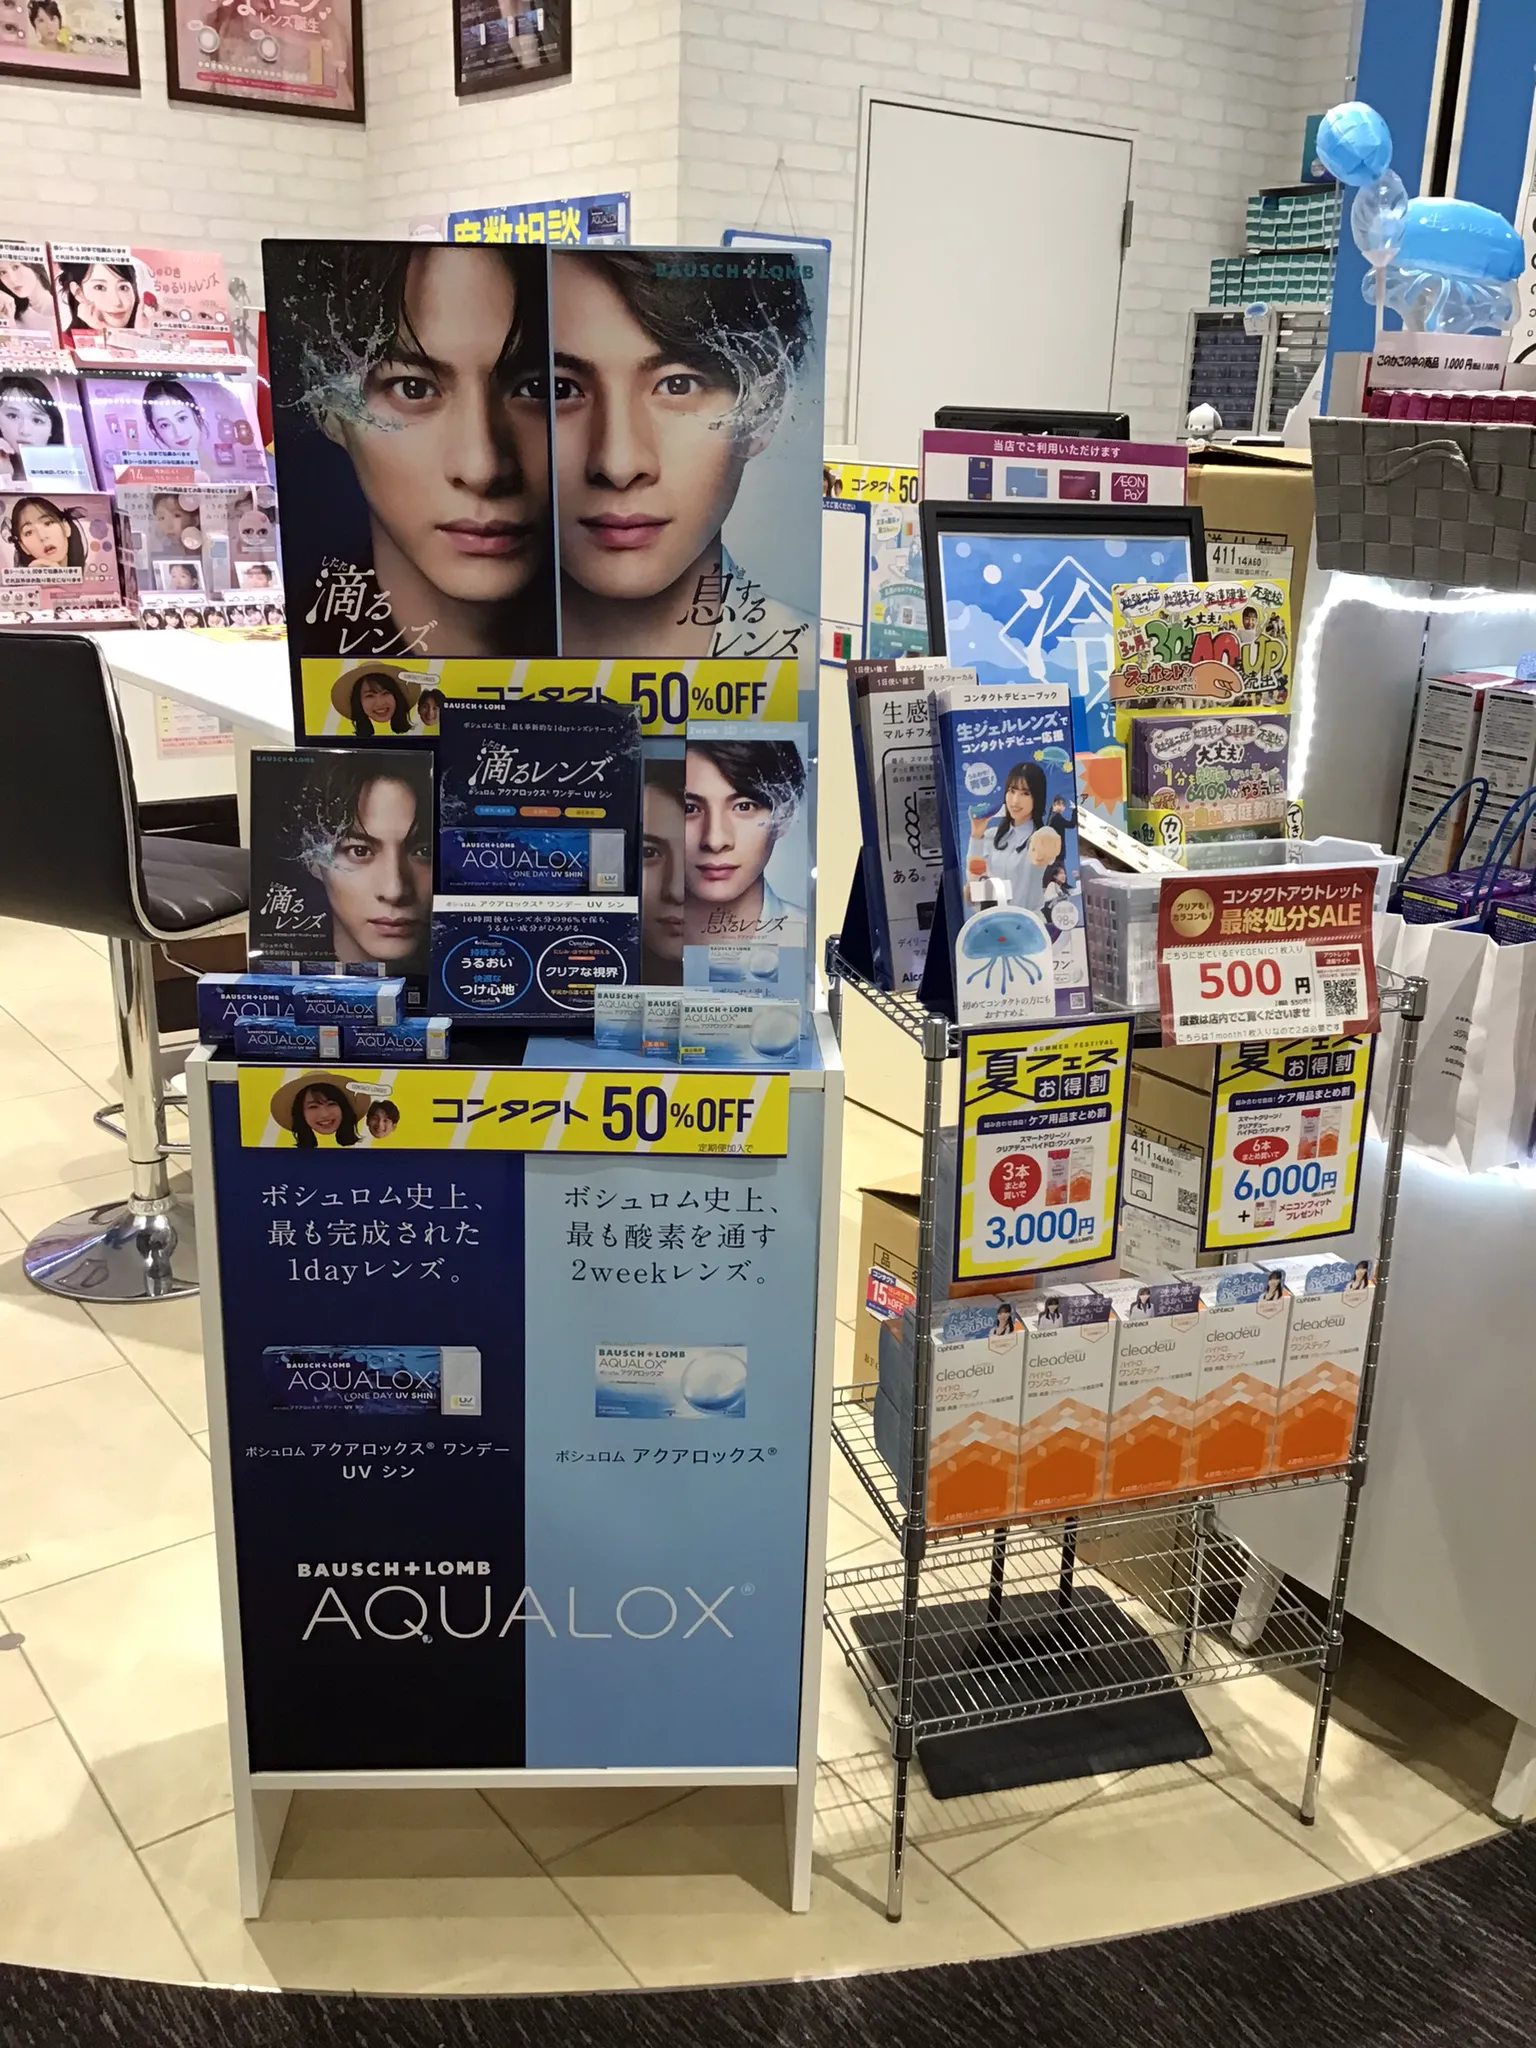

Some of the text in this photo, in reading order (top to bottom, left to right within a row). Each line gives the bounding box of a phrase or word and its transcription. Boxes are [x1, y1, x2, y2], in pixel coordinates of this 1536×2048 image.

[260, 12, 321, 34] レンズ誕生
[1376, 355, 1440, 369] このかごの中の商品
[993, 438, 1121, 459] 当店でご利用いただけます
[851, 478, 896, 494] コンタクト
[321, 556, 349, 572] したた
[1213, 546, 1236, 566] 411
[305, 564, 394, 625] 滴る
[676, 562, 767, 626] 息する
[339, 620, 439, 657] レンズ
[711, 623, 810, 658] レンズ
[876, 674, 974, 686] 1日使い捨て マルチフォーカル
[443, 702, 506, 710] BAUSCH+LOMB
[963, 691, 1058, 703] コンタクトデビューブック
[956, 711, 1069, 743] 生ジェルレンズで
[961, 729, 1065, 754] コンタクトデビュー応援
[1197, 743, 1244, 766] 大丈夫!
[468, 743, 614, 787] 滴るレンズ
[468, 788, 613, 799] ボシュロム ワンデー UV シン
[461, 850, 584, 870] AQUALOX
[893, 868, 928, 884] ある。
[260, 886, 305, 915] 滴る
[1222, 882, 1364, 905] コンタクトアウトレット
[547, 900, 625, 909] ワンデー UV シン
[1176, 901, 1211, 912] クリアも!
[274, 911, 327, 931] レンズ
[462, 915, 611, 925] 16時間後もレンズ水分の96%を保ち、
[700, 906, 789, 934] 息するレンズ
[1172, 911, 1213, 923] カラコンも!
[1219, 902, 1362, 936] 最終処分SALE
[486, 924, 584, 933] うるおい成分がひろがる。
[470, 948, 507, 957] 持続する
[1165, 945, 1304, 961] こちらに出ているEYEGENIC1枚入り
[545, 965, 619, 978] クリアな視界
[1198, 957, 1283, 1000] 500
[1294, 976, 1312, 995] 円
[220, 993, 280, 1001] BAUSCH+LOMB
[459, 983, 516, 996] つけ心地
[306, 1003, 373, 1015] AQUALOX
[684, 1006, 754, 1014] BAUSCH+LOMB
[961, 996, 1051, 1011] 初めてコンタクトの方にも
[984, 1007, 1031, 1020] おすすめよ。
[1179, 1007, 1311, 1031] 度数は店内でご覧くださいませ
[247, 1033, 317, 1045] AQUALOX
[356, 1035, 424, 1048] AQUALOX
[1177, 1023, 1342, 1044] こちらは1month1枚入りなので2点必要です
[1033, 1038, 1115, 1053] SUMMER FESTIVAL
[1288, 1052, 1353, 1078] お得割
[964, 1046, 1119, 1107] 夏フェス
[1038, 1073, 1108, 1100] お得割
[1277, 1085, 1351, 1105] ケア用品まとめ割
[432, 1097, 590, 1126] コンタクト
[1027, 1107, 1107, 1127] ケア用品まとめ割
[697, 1142, 755, 1155] 定期便加入で
[1130, 1138, 1151, 1160] 411
[1251, 1138, 1272, 1152] 6本
[1241, 1149, 1281, 1161] まとめ買いで
[1001, 1161, 1030, 1181] 3本
[1003, 1180, 1027, 1191] まとめ
[1232, 1160, 1338, 1202] 6,000円
[261, 1184, 484, 1213] ボシュロム史上、
[564, 1186, 780, 1215] ボシュロム史上、
[1002, 1189, 1027, 1202] 買いで
[1278, 1197, 1333, 1213] メニコンフィット
[1285, 1208, 1325, 1222] プレゼント!
[267, 1219, 481, 1248] 最も完成された
[566, 1221, 779, 1249] 最も酸素を通す
[984, 1206, 1096, 1250] 3,000円
[289, 1255, 463, 1287] 1dayレンズ。
[572, 1259, 769, 1286] 2weekレンズ。
[872, 1269, 896, 1285] コンタクト
[871, 1279, 888, 1306] 15
[1292, 1315, 1346, 1333] cleadew
[1205, 1325, 1261, 1344] cleadew
[598, 1349, 686, 1359] BAUSCH+LOMB
[1120, 1340, 1177, 1359] cleadew
[1290, 1340, 1331, 1353] ワンステップ
[1029, 1350, 1087, 1370] cleadew
[1204, 1350, 1246, 1364] ワンステップ
[936, 1363, 995, 1383] cleadew
[1118, 1365, 1161, 1378] ワンステップ
[287, 1370, 434, 1392] AQUALOX
[1027, 1376, 1071, 1390] ワンステップ
[349, 1392, 433, 1400] ONE DAY UV SHIN
[935, 1389, 979, 1404] ワンステップ
[245, 1445, 306, 1458] ボシュロム
[443, 1441, 510, 1458] ワンデー
[555, 1449, 626, 1464] ボシュロム
[342, 1465, 415, 1480] UV シン
[297, 1560, 493, 1579] BAUSCH+LOMB
